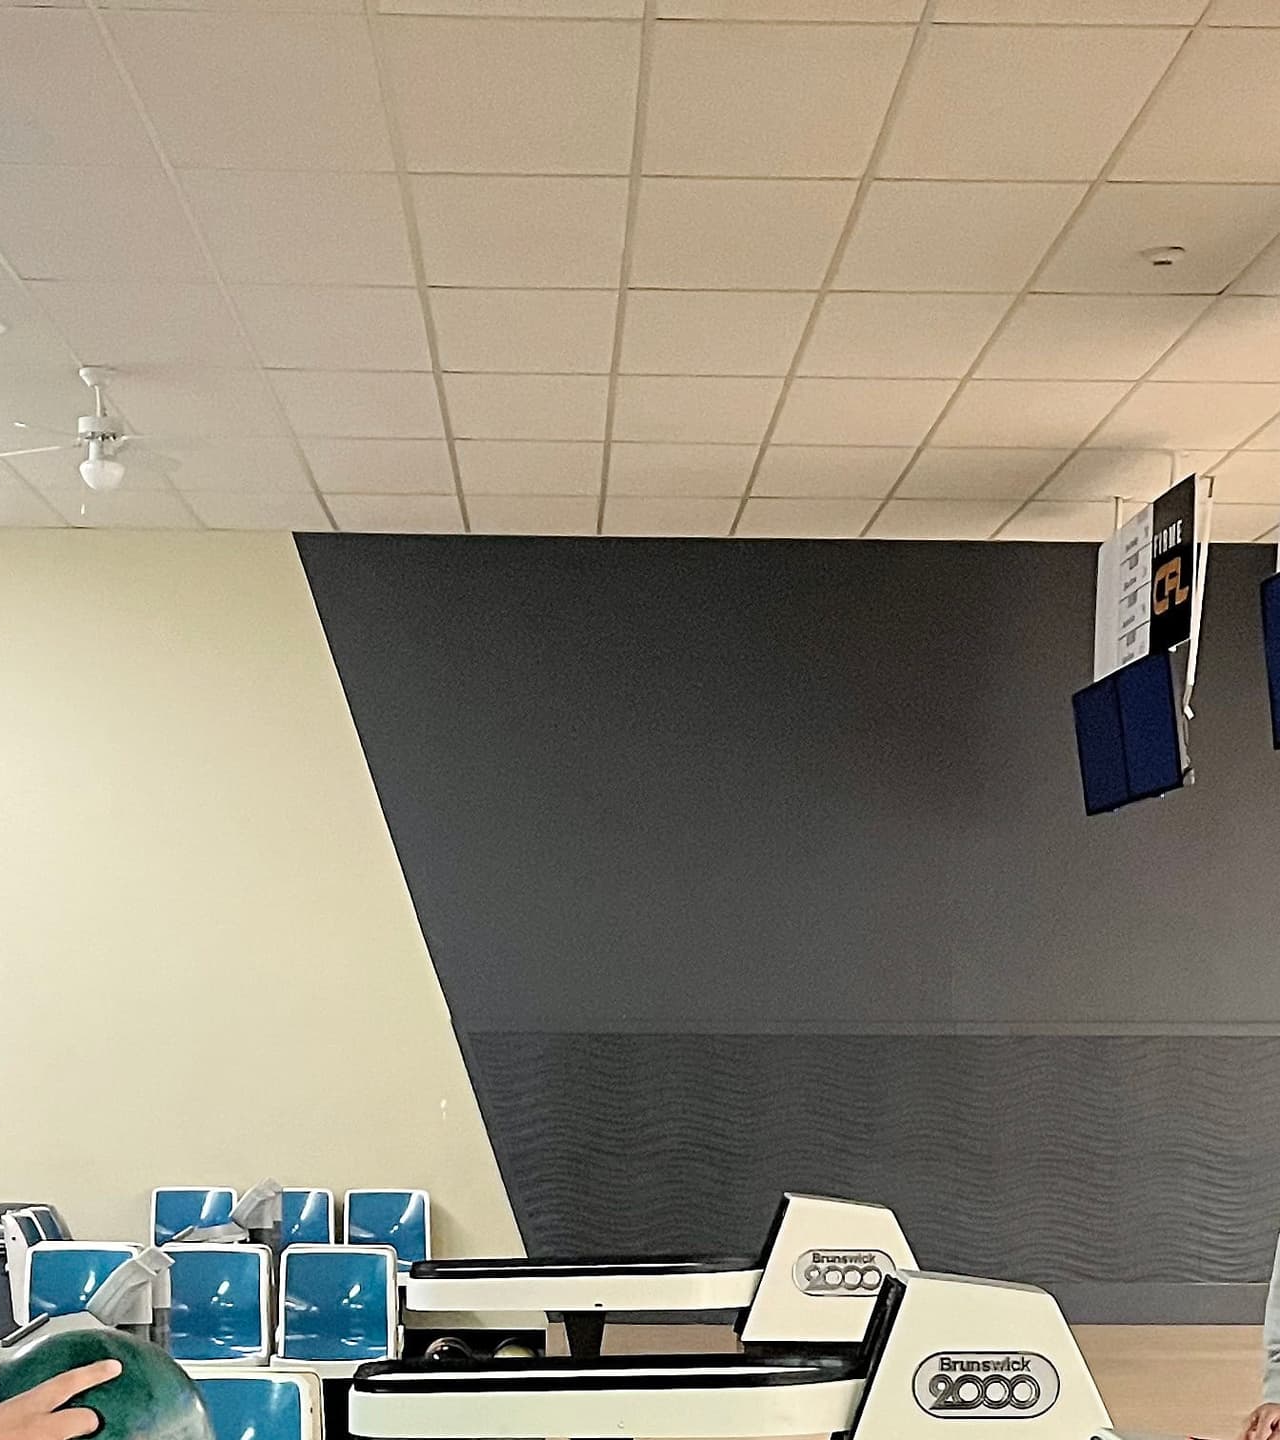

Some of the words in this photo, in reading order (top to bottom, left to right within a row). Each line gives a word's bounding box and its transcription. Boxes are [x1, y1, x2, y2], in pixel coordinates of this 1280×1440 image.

[1153, 519, 1184, 558] FIRME
[812, 1252, 877, 1265] Brunswick
[803, 1265, 883, 1291] 2000
[939, 1356, 1031, 1373] Brunswick
[929, 1374, 1041, 1410] 2000
